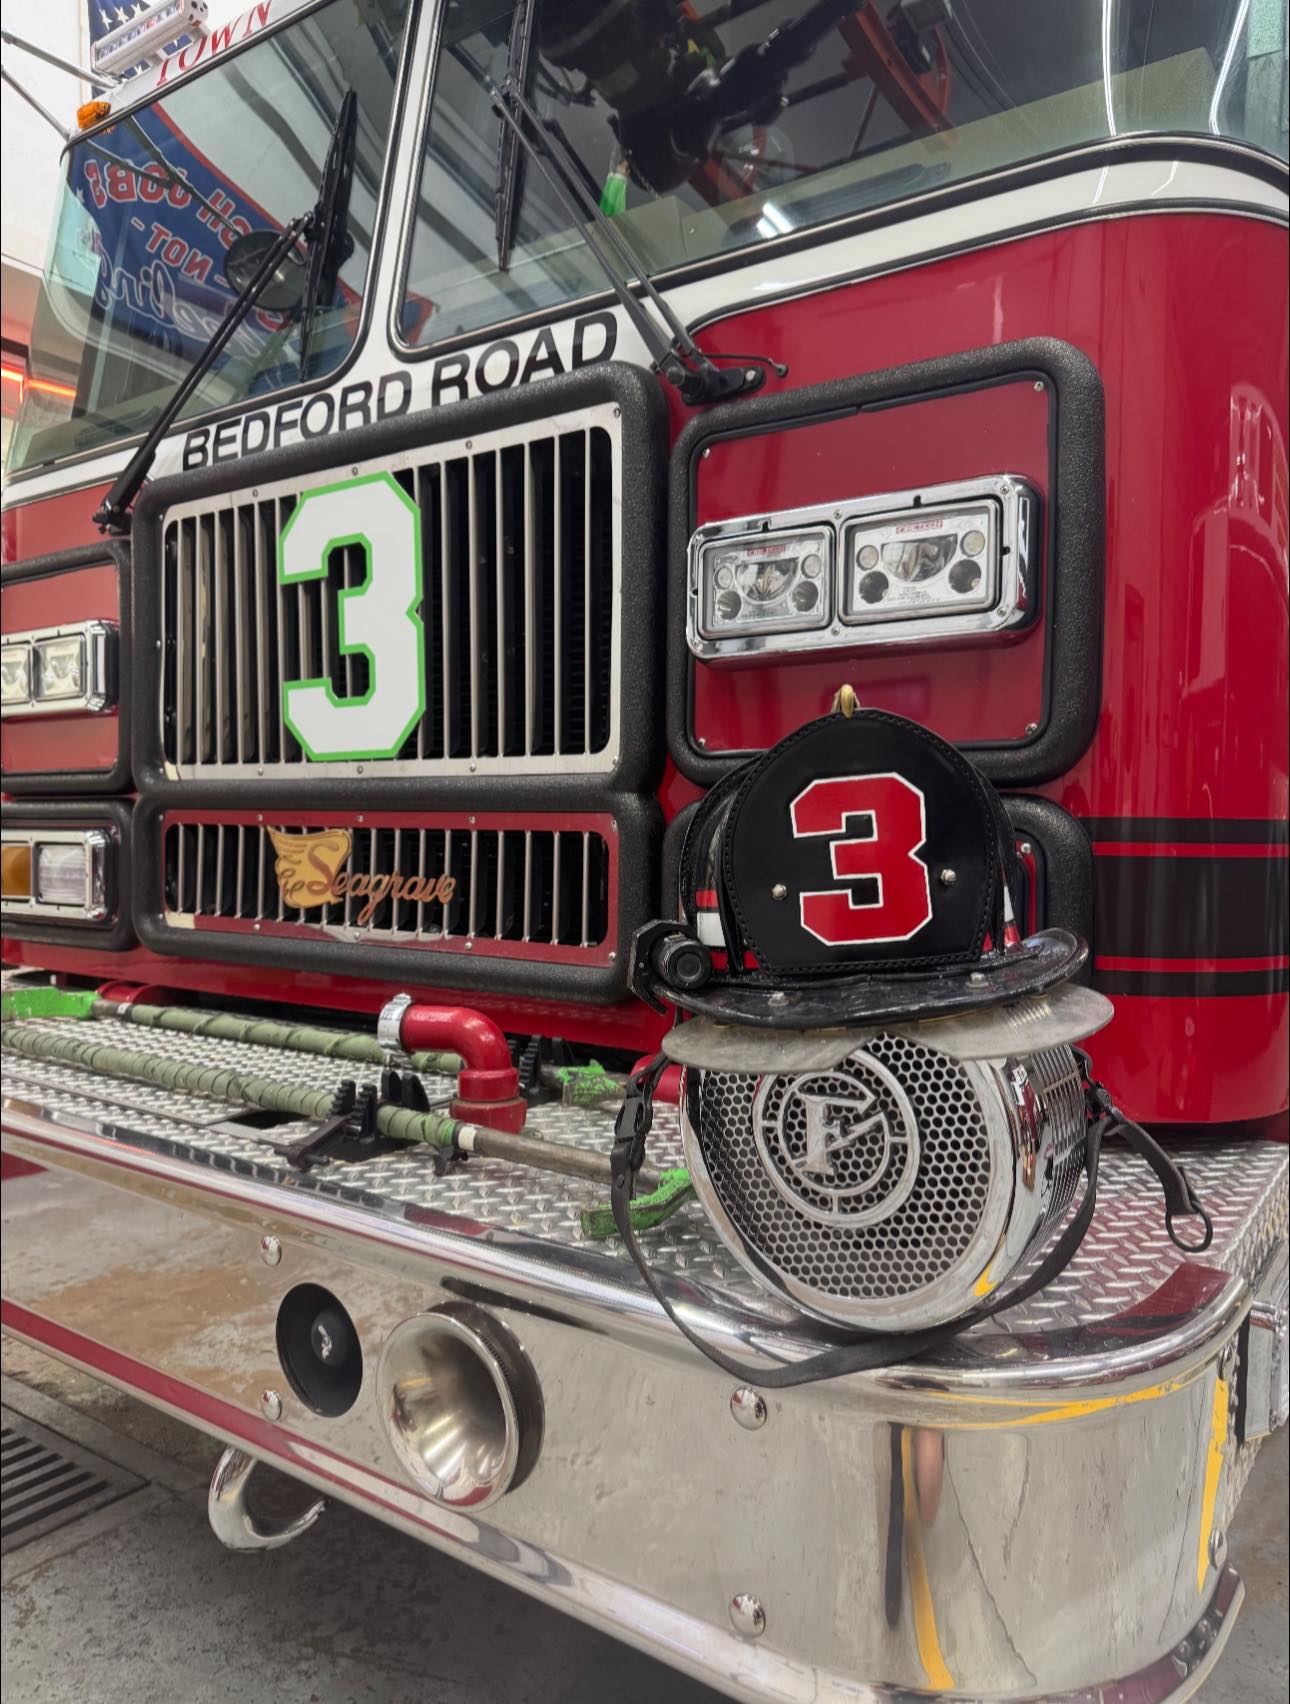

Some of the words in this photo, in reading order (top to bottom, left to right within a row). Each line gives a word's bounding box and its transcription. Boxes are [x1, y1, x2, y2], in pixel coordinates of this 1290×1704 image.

[182, 369, 413, 472] BEDFORD
[431, 311, 618, 408] ROAD
[277, 470, 427, 762] 3
[306, 840, 457, 926] Seagrave
[789, 771, 933, 947] 3
